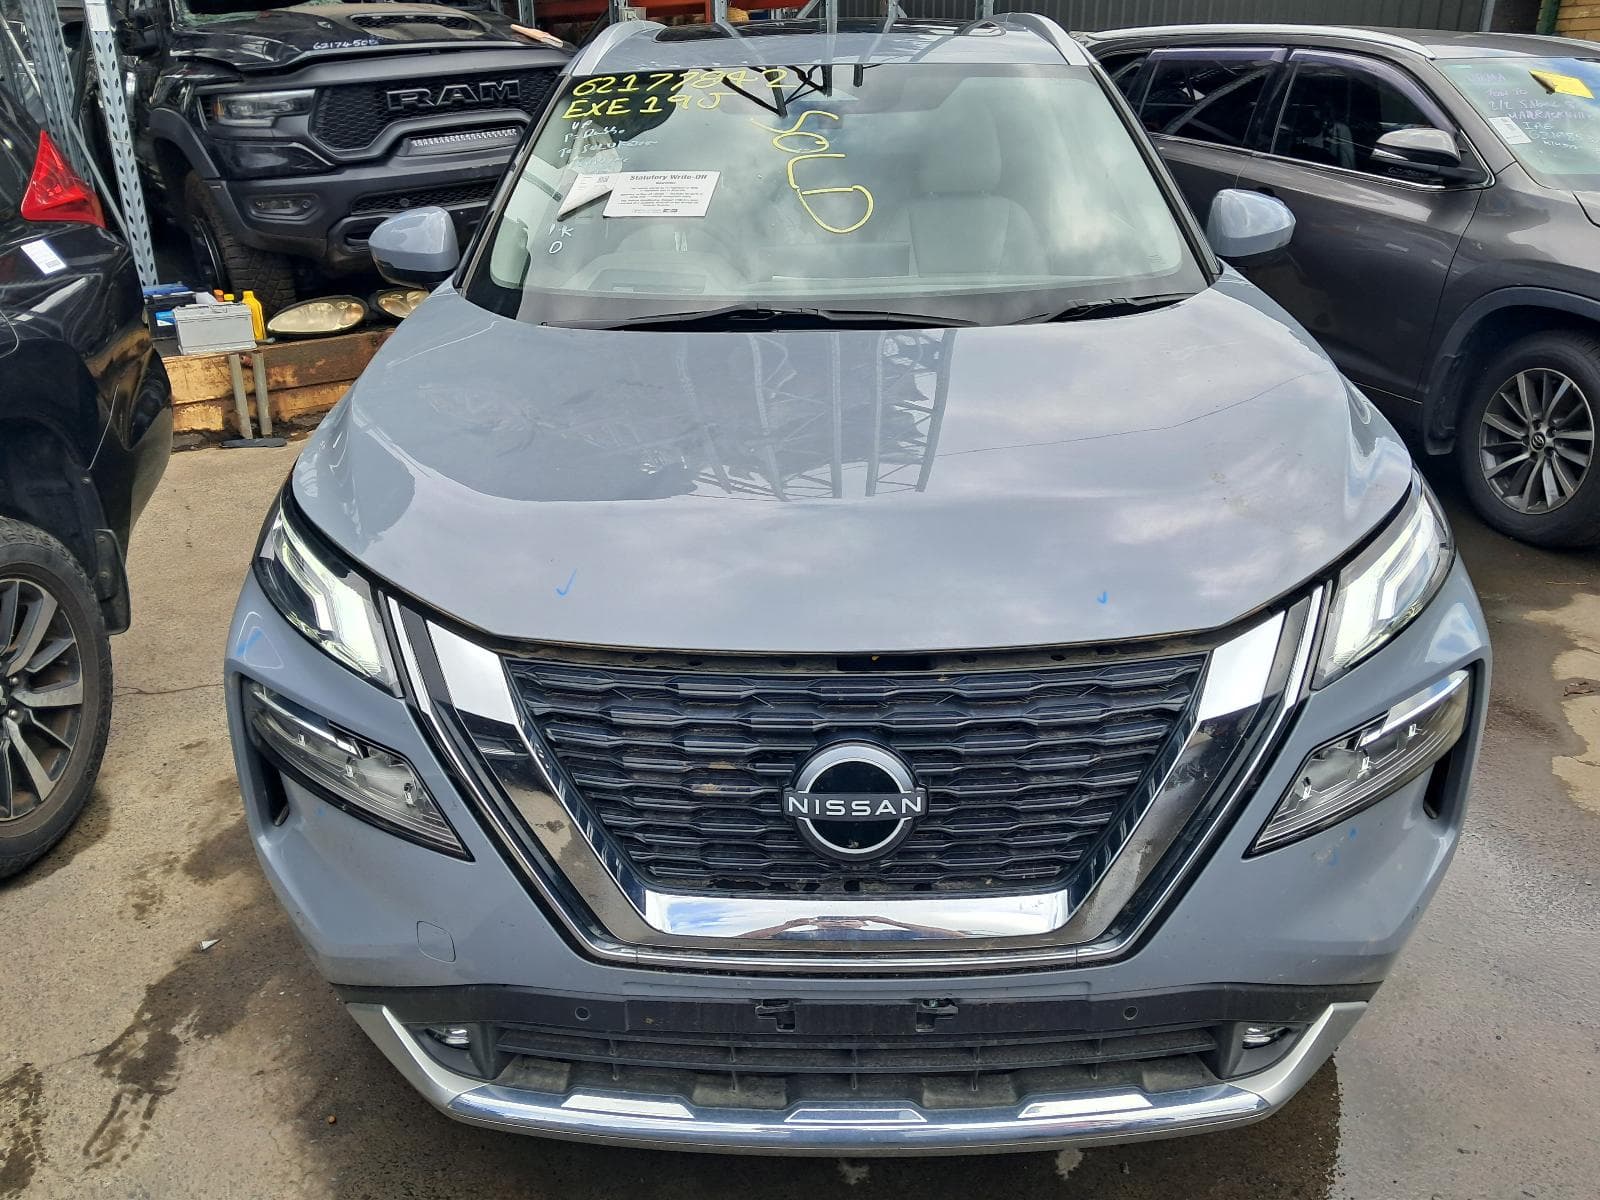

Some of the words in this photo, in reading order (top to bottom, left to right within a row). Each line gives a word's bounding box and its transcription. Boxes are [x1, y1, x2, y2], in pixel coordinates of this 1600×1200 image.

[386, 79, 520, 110] RAM
[562, 98, 631, 118] EXE
[788, 796, 922, 816] NISSAN
